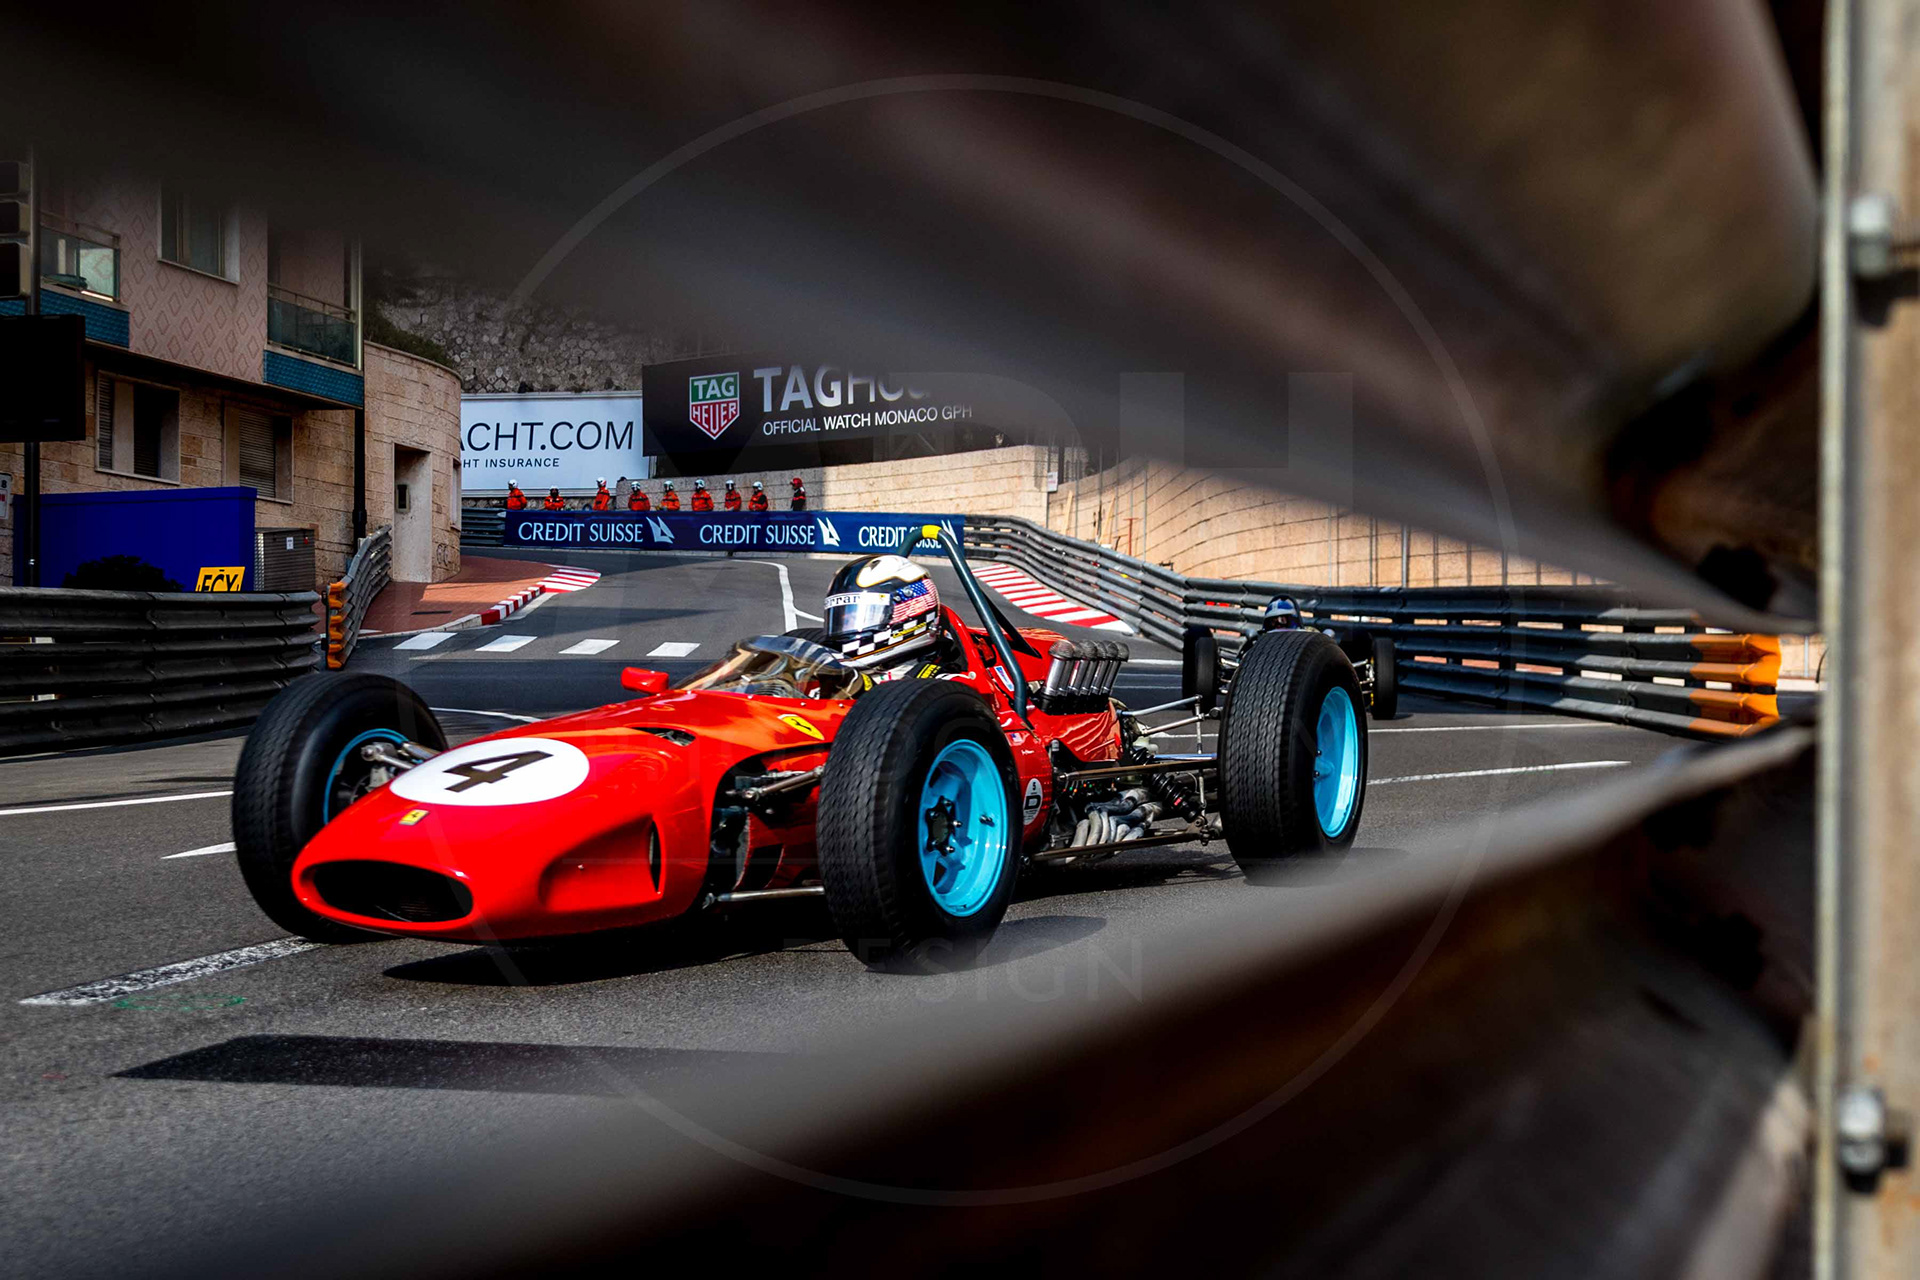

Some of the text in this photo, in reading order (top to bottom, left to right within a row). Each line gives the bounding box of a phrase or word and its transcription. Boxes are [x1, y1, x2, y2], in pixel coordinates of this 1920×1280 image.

[693, 377, 735, 399] TAG
[692, 402, 737, 434] HEUER
[763, 418, 821, 435] OFFICIAL
[823, 412, 871, 430] WATCH
[874, 407, 938, 426] MONACO
[485, 457, 560, 468] INSURANCE
[518, 521, 644, 542] CREDIT SUISSE
[699, 524, 816, 546] CREDIT SUISSE
[858, 525, 908, 548] CREDIT
[441, 750, 554, 793] 4
